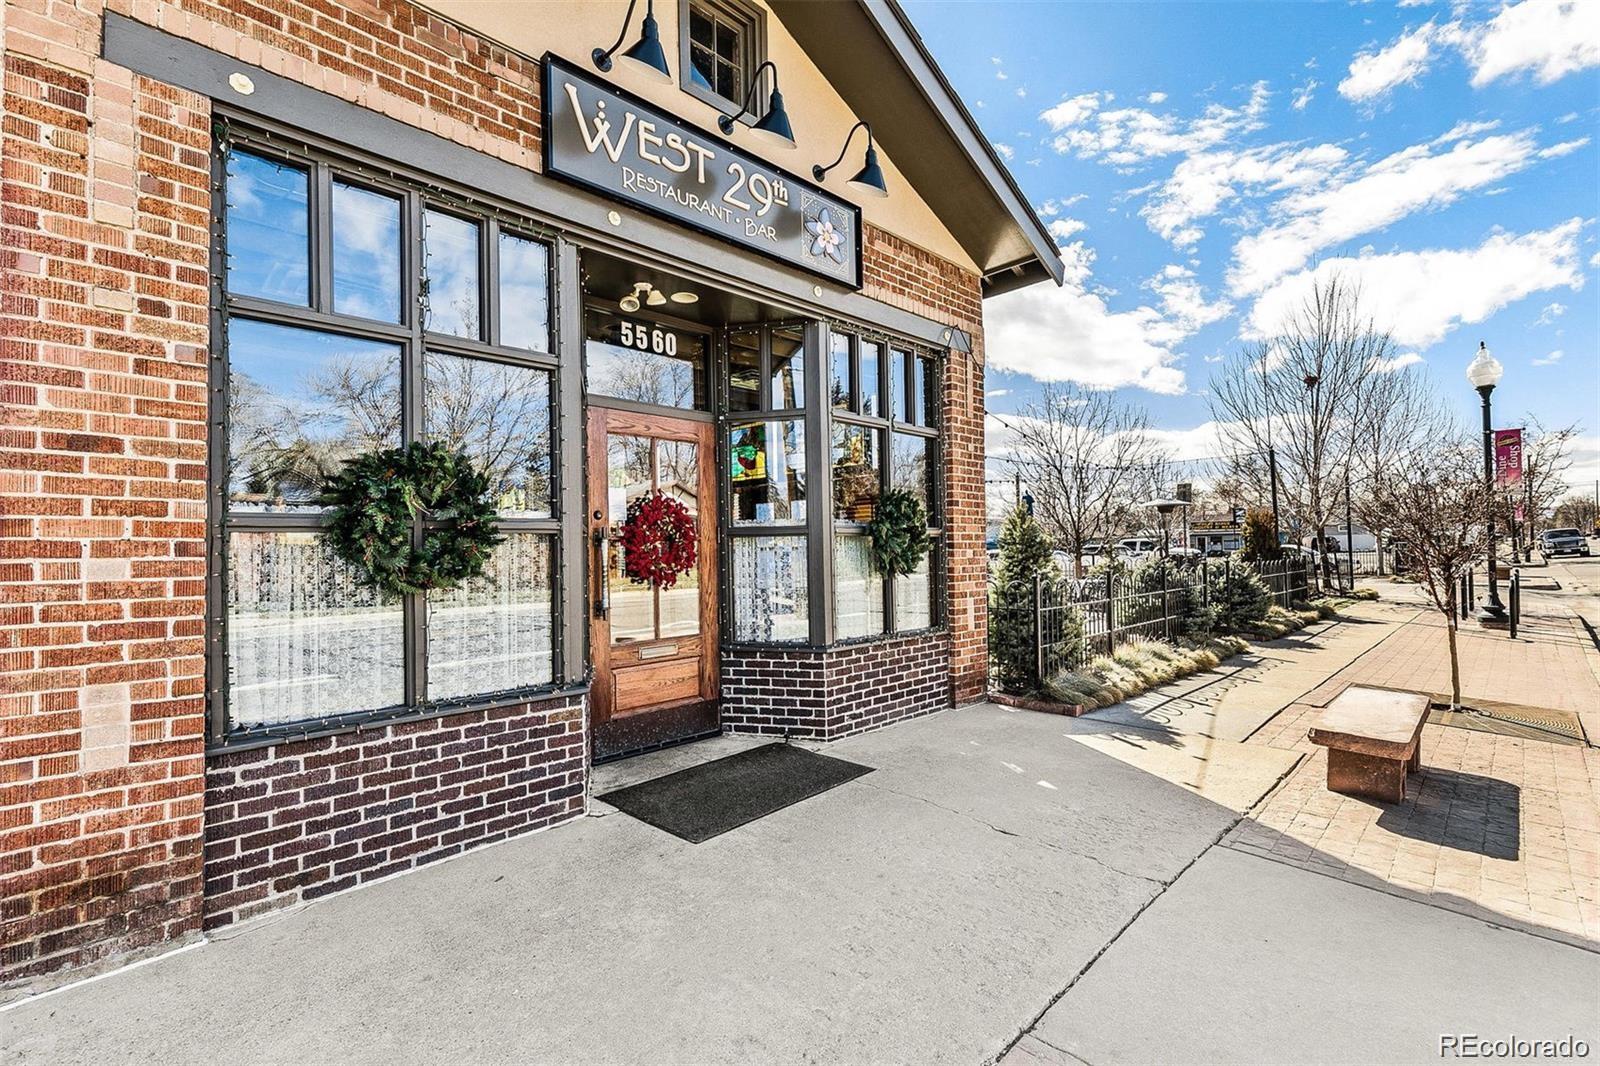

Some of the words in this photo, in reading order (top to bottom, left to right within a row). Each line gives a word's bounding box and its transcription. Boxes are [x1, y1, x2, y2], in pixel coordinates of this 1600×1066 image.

[563, 82, 715, 184] WEST
[723, 162, 789, 218] 29th
[621, 166, 734, 224] RESTAURANT
[744, 217, 778, 243] BAR
[620, 320, 677, 357] 5560
[1509, 445, 1520, 468] Shop
